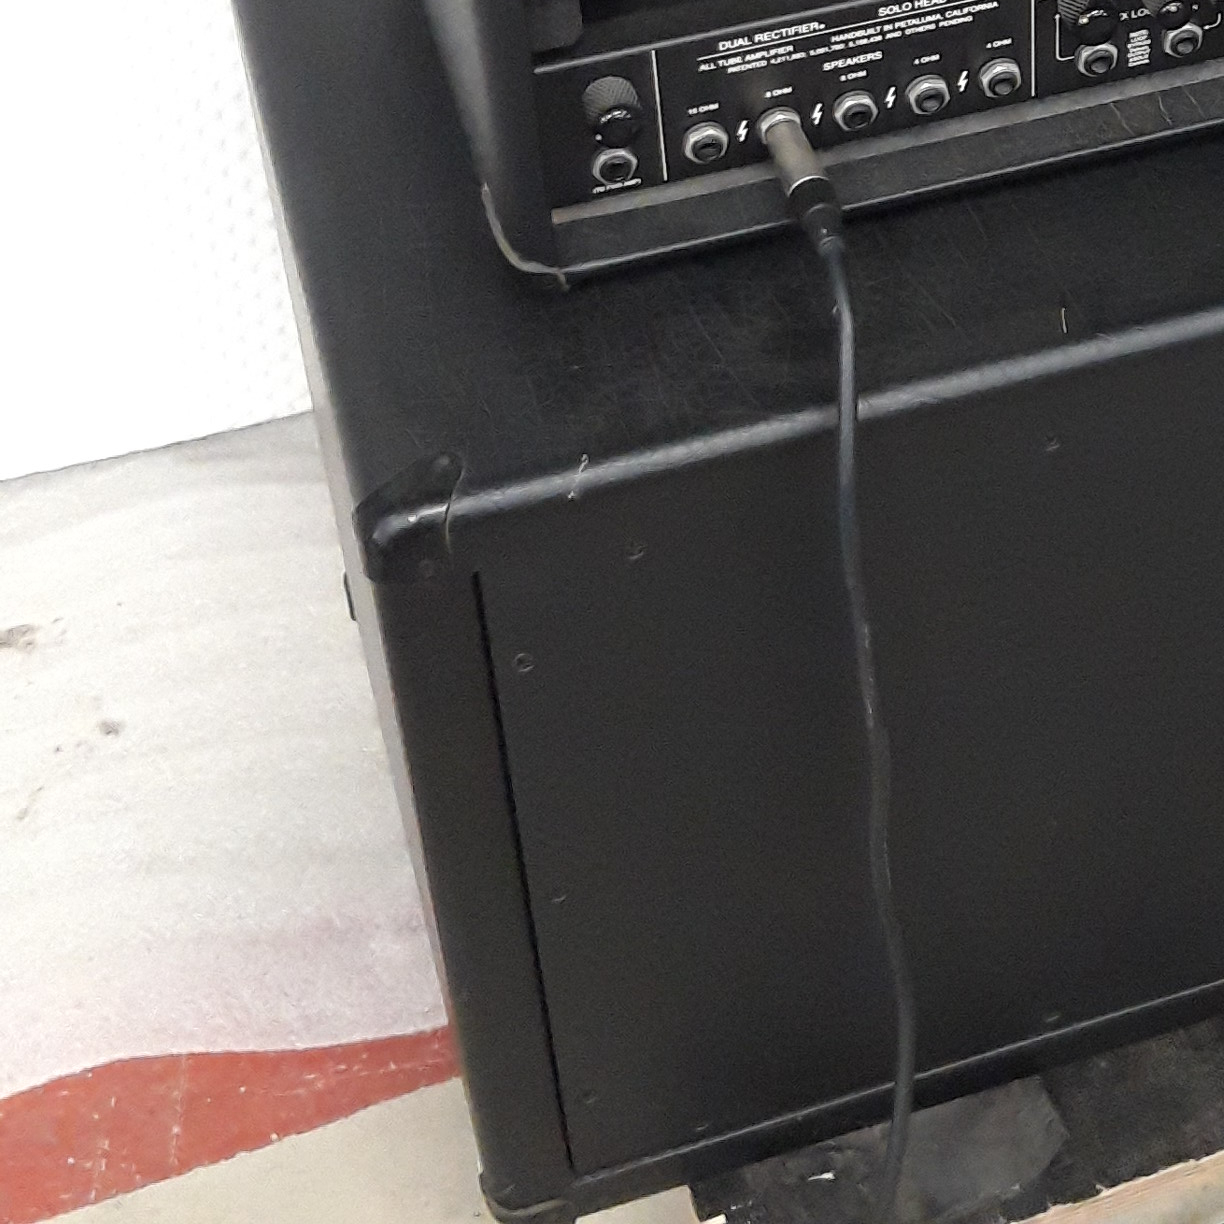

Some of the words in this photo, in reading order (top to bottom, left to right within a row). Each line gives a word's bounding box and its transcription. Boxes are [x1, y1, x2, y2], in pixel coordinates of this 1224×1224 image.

[878, 1, 913, 17] SOLO
[831, 25, 882, 43] HANDBUILT
[883, 22, 894, 32] IN
[945, 1, 999, 19] CALIFORNIA
[718, 36, 752, 52] DUAL
[744, 45, 794, 62] AMPLIFIER
[822, 50, 883, 72] SPEAKERS
